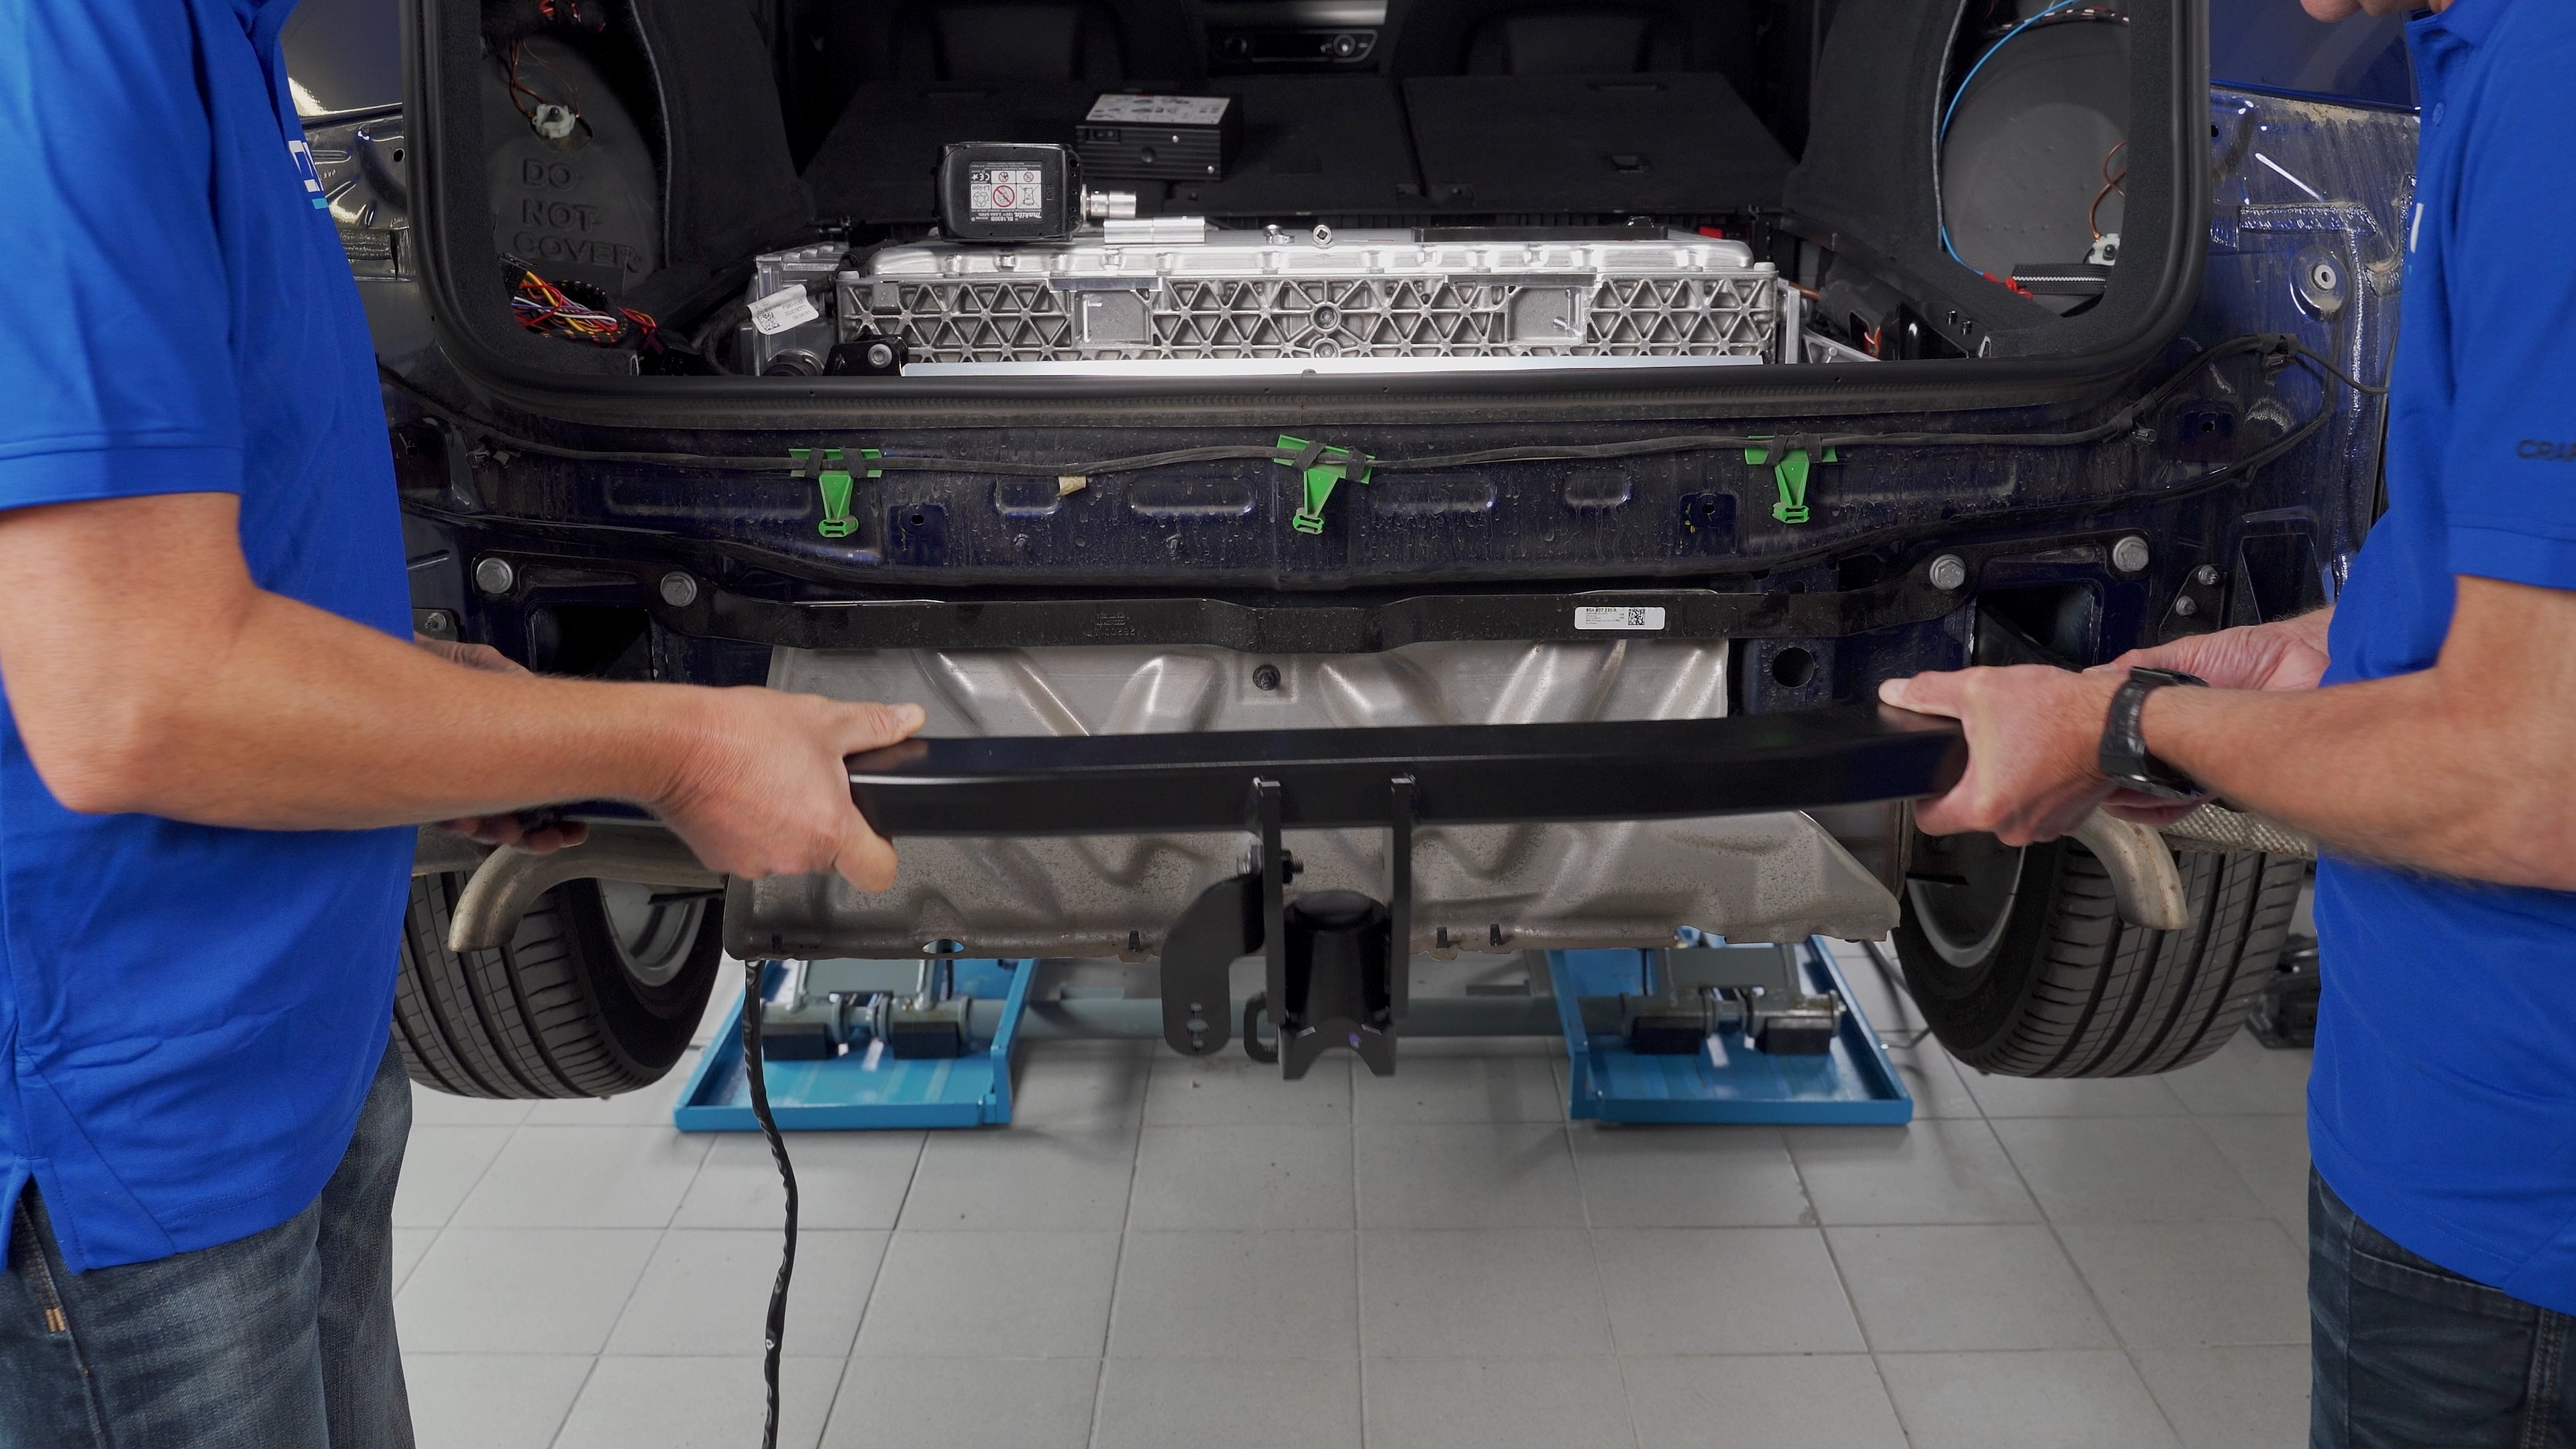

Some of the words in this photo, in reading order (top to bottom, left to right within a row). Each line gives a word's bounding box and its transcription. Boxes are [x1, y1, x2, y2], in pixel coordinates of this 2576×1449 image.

[523, 158, 577, 191] DO
[522, 199, 598, 233] NOT
[513, 231, 641, 273] COVER
